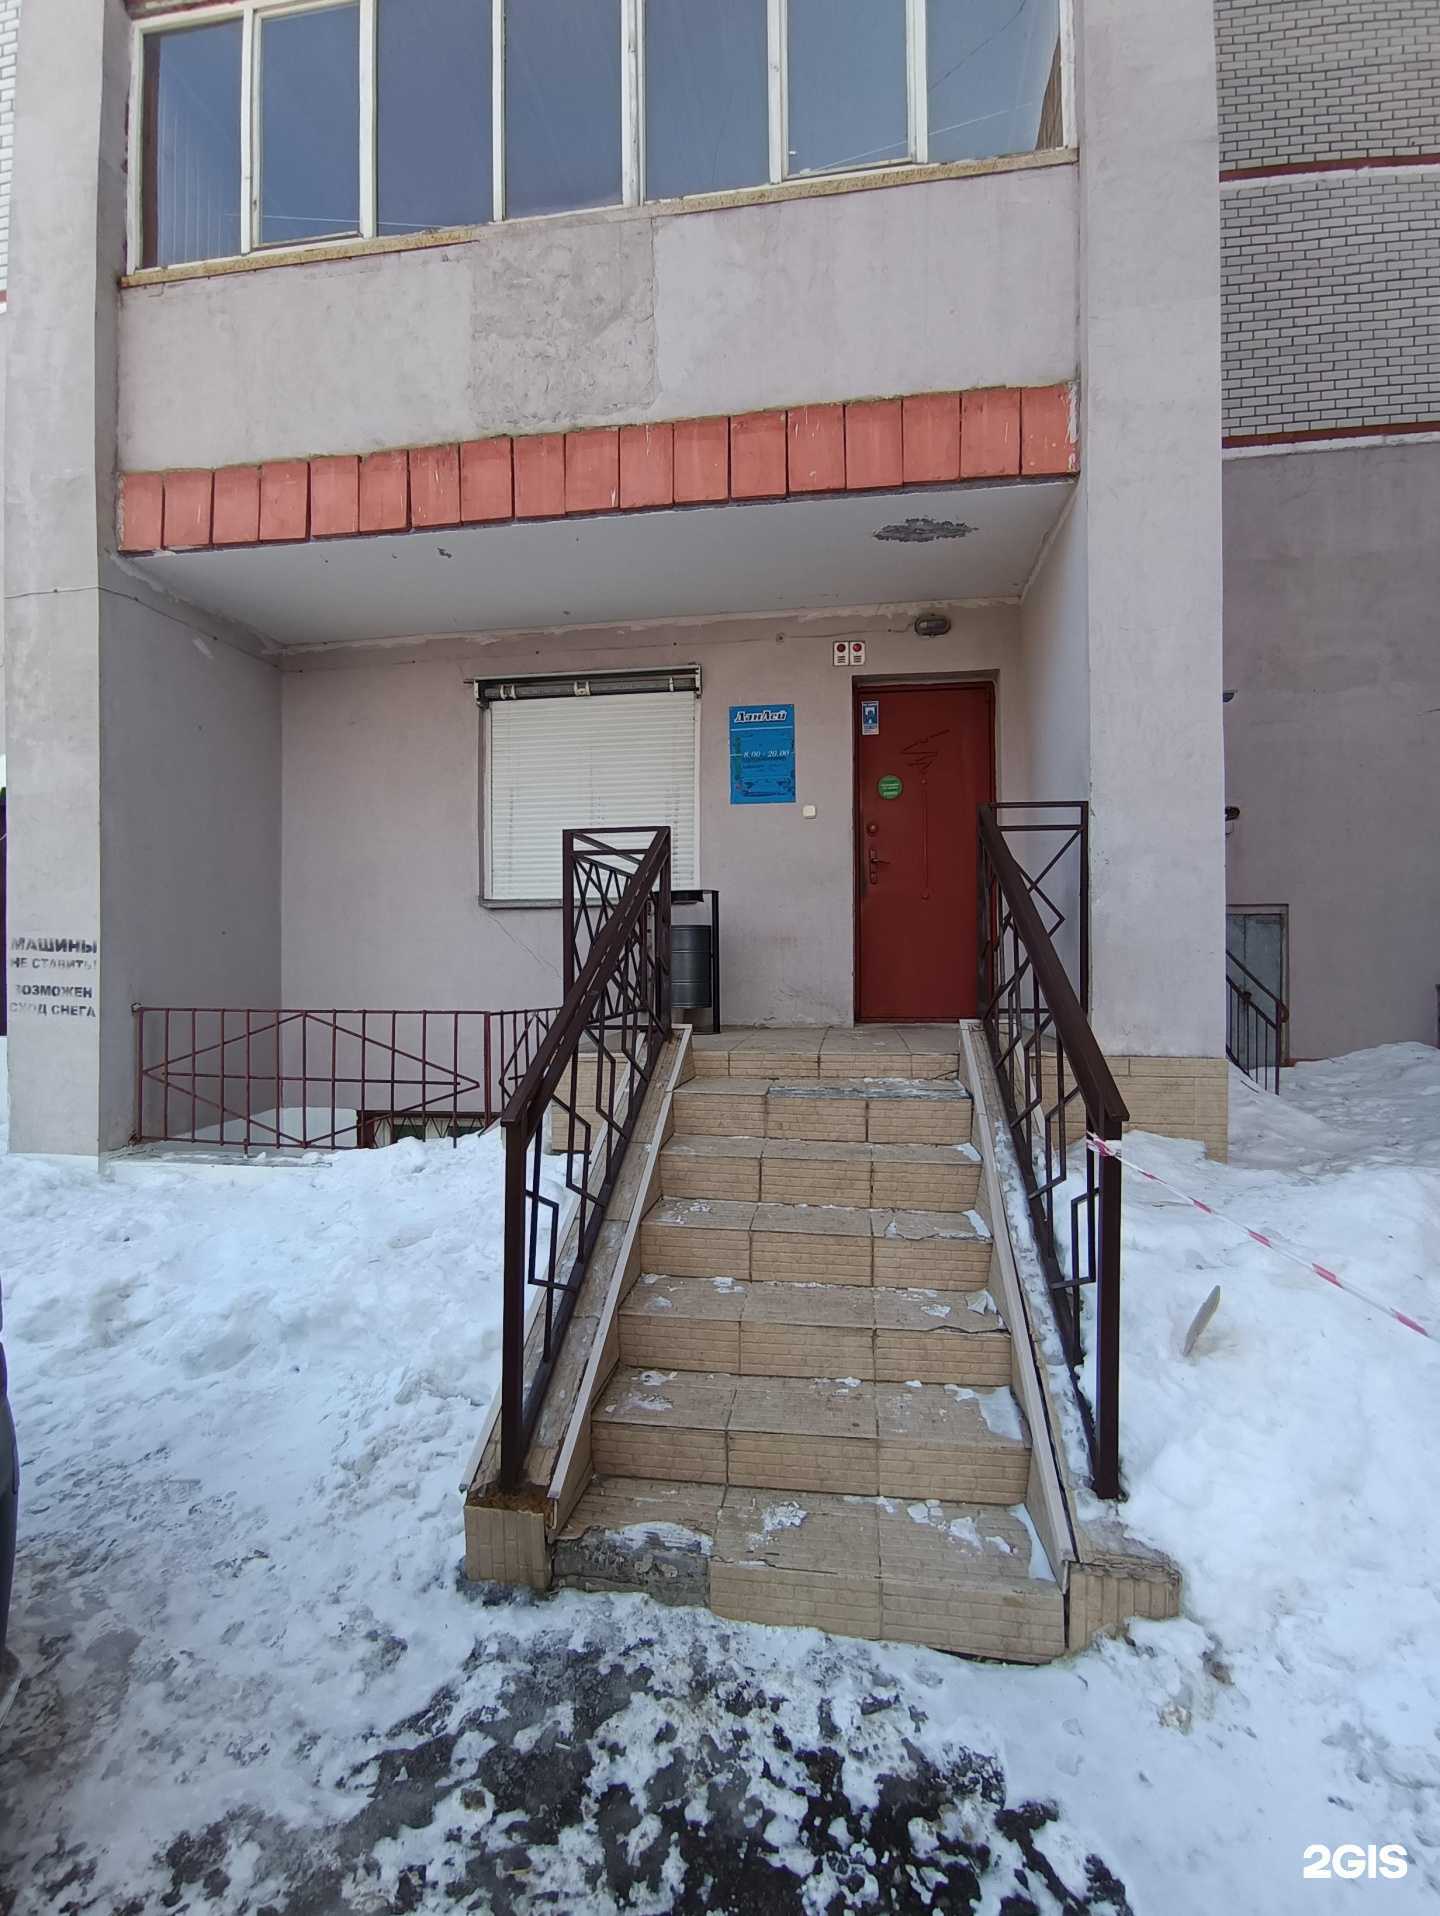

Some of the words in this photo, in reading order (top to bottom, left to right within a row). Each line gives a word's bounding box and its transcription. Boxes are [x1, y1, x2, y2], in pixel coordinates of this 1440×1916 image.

[11, 937, 97, 953] МАШИНЫ
[10, 957, 28, 968] НЕ
[51, 1004, 96, 1017] СНЕГА
